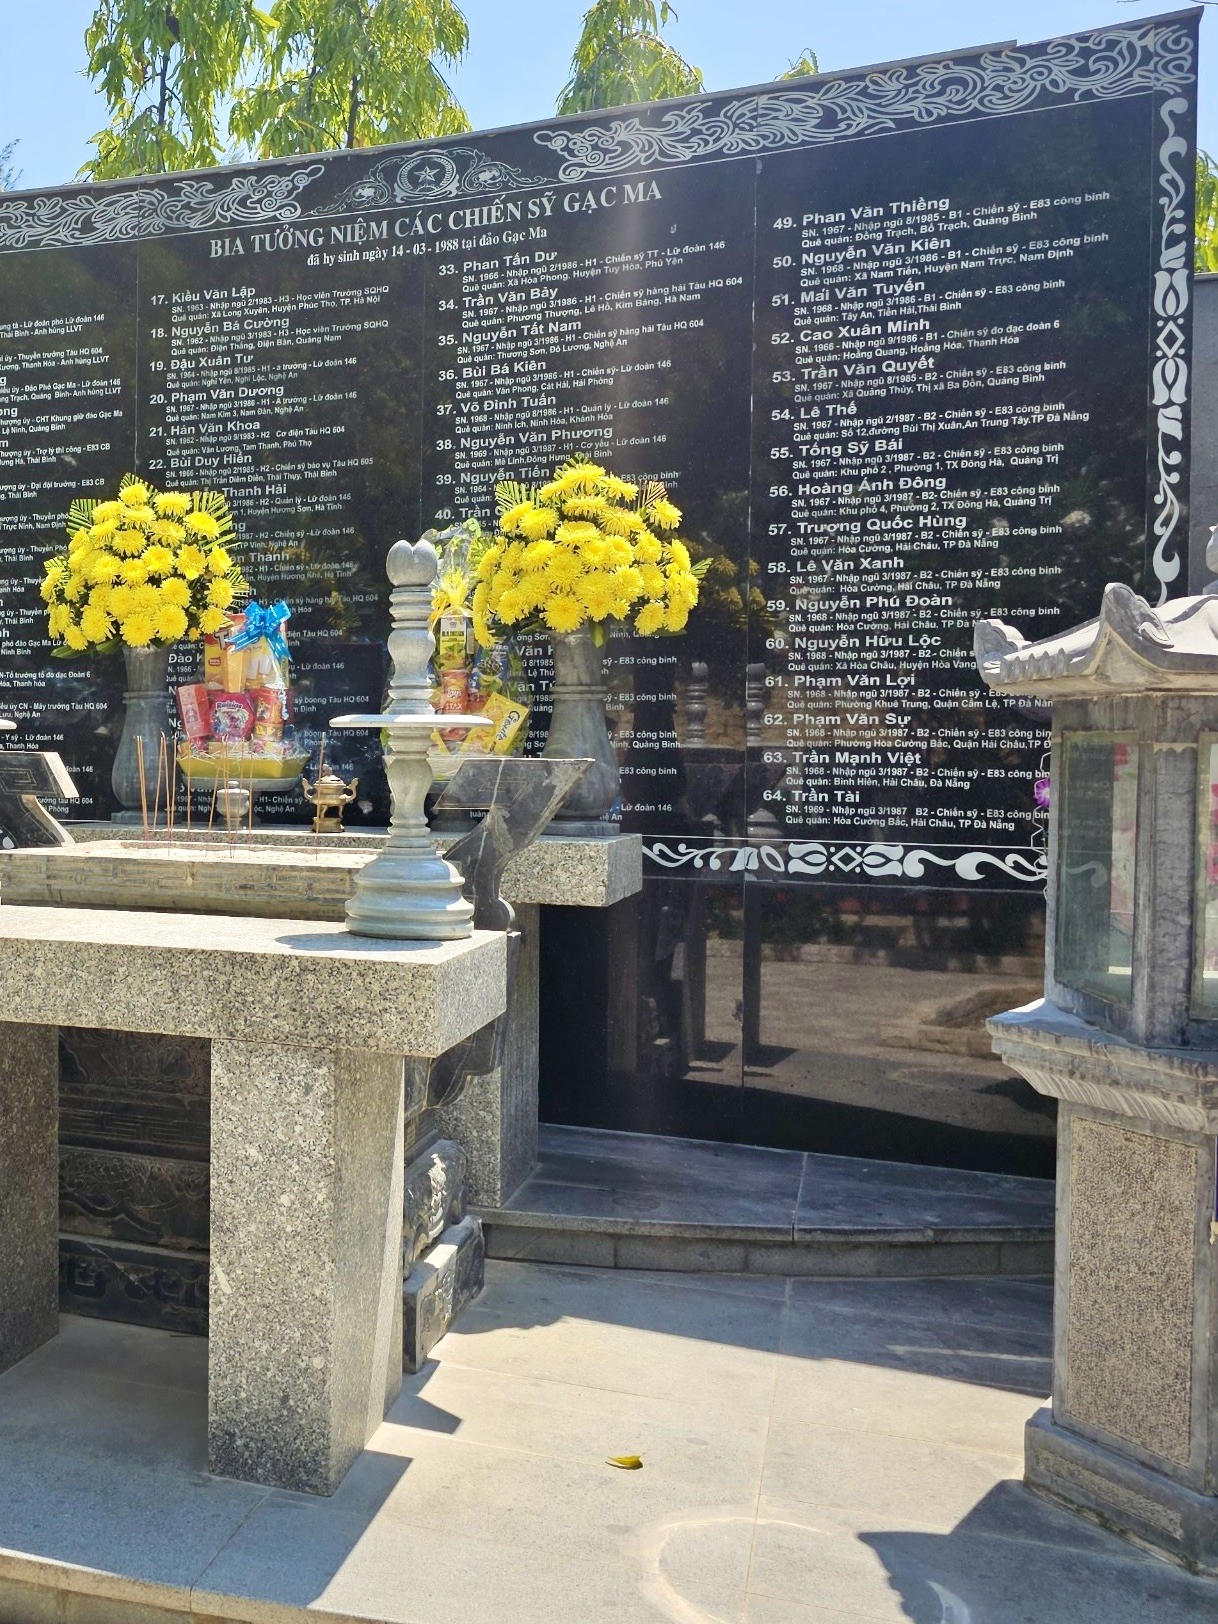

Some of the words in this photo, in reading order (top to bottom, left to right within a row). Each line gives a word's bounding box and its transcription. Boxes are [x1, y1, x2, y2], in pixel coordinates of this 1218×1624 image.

[210, 236, 245, 258] BIA
[250, 224, 324, 253] TƯỞNG
[330, 217, 388, 245] NIỆM
[394, 210, 442, 237] CÁC
[448, 194, 522, 230] CHIẾN
[527, 191, 556, 219] SỸ
[563, 186, 616, 214] GẠC
[622, 180, 662, 204] MA
[772, 216, 797, 229] 49.
[802, 212, 845, 226] Phan
[850, 205, 883, 219] Văn
[888, 196, 949, 214] Thiềng
[306, 253, 320, 266] đã
[322, 252, 336, 266] hy
[337, 249, 360, 262] sinh
[362, 246, 388, 262] ngày
[391, 244, 403, 257] 14
[412, 242, 426, 255] 03
[435, 237, 459, 253] 1988
[461, 235, 476, 251] tại
[478, 231, 499, 246] đảo
[502, 230, 526, 244] Gạc
[528, 226, 547, 240] Ma
[772, 255, 796, 268] 50.
[801, 244, 866, 266] Nguyễn
[871, 240, 905, 256] Văn
[910, 234, 952, 252] Kiên
[438, 263, 458, 276] 33.
[463, 259, 499, 272] Phan
[502, 251, 529, 267] Tấn
[534, 251, 557, 263] Dư
[150, 294, 168, 305] 17.
[172, 289, 200, 303] Kiều
[203, 288, 227, 299] Văn
[231, 285, 255, 299] Lập
[438, 298, 458, 311] 34.
[462, 289, 494, 308] Trần
[497, 290, 525, 303] Văn
[530, 286, 558, 299] Bảy
[150, 327, 167, 338] 18.
[171, 318, 219, 338] Nguyễn
[222, 317, 241, 332] Bá
[243, 315, 290, 330] Cường
[437, 333, 458, 346] 35.
[462, 322, 518, 344] Nguyễn
[519, 319, 544, 336] Tất
[548, 319, 582, 333] Nam
[770, 331, 794, 345] 52.
[799, 327, 833, 342] Cao
[837, 321, 881, 338] Xuân
[887, 316, 930, 333] Minh
[149, 393, 168, 404] 20.
[170, 389, 207, 404] Phạm
[208, 386, 235, 399] Văn
[238, 384, 285, 397] Dương
[435, 438, 456, 450] 38.
[459, 431, 514, 450] Nguyễn
[518, 429, 546, 443] Văn
[551, 425, 613, 440] Phương
[769, 446, 794, 459] 55.
[797, 438, 842, 457] Tống
[847, 438, 869, 456] Sỹ
[874, 435, 903, 451] Bái
[148, 458, 167, 470] 22.
[169, 454, 193, 468] Bùi
[194, 454, 220, 468] Duy
[763, 599, 790, 611] 59.
[794, 591, 860, 612] Nguyễn
[865, 592, 902, 608] Phú
[904, 591, 955, 607] Đoàn
[764, 675, 788, 687] 61.
[794, 673, 841, 689] Phạm
[845, 671, 880, 686] Văn
[884, 671, 916, 688] Lợi
[445, 702, 463, 711] STAX
[762, 787, 786, 801] 64.
[791, 784, 829, 802] Trần
[833, 790, 860, 803] Tài
